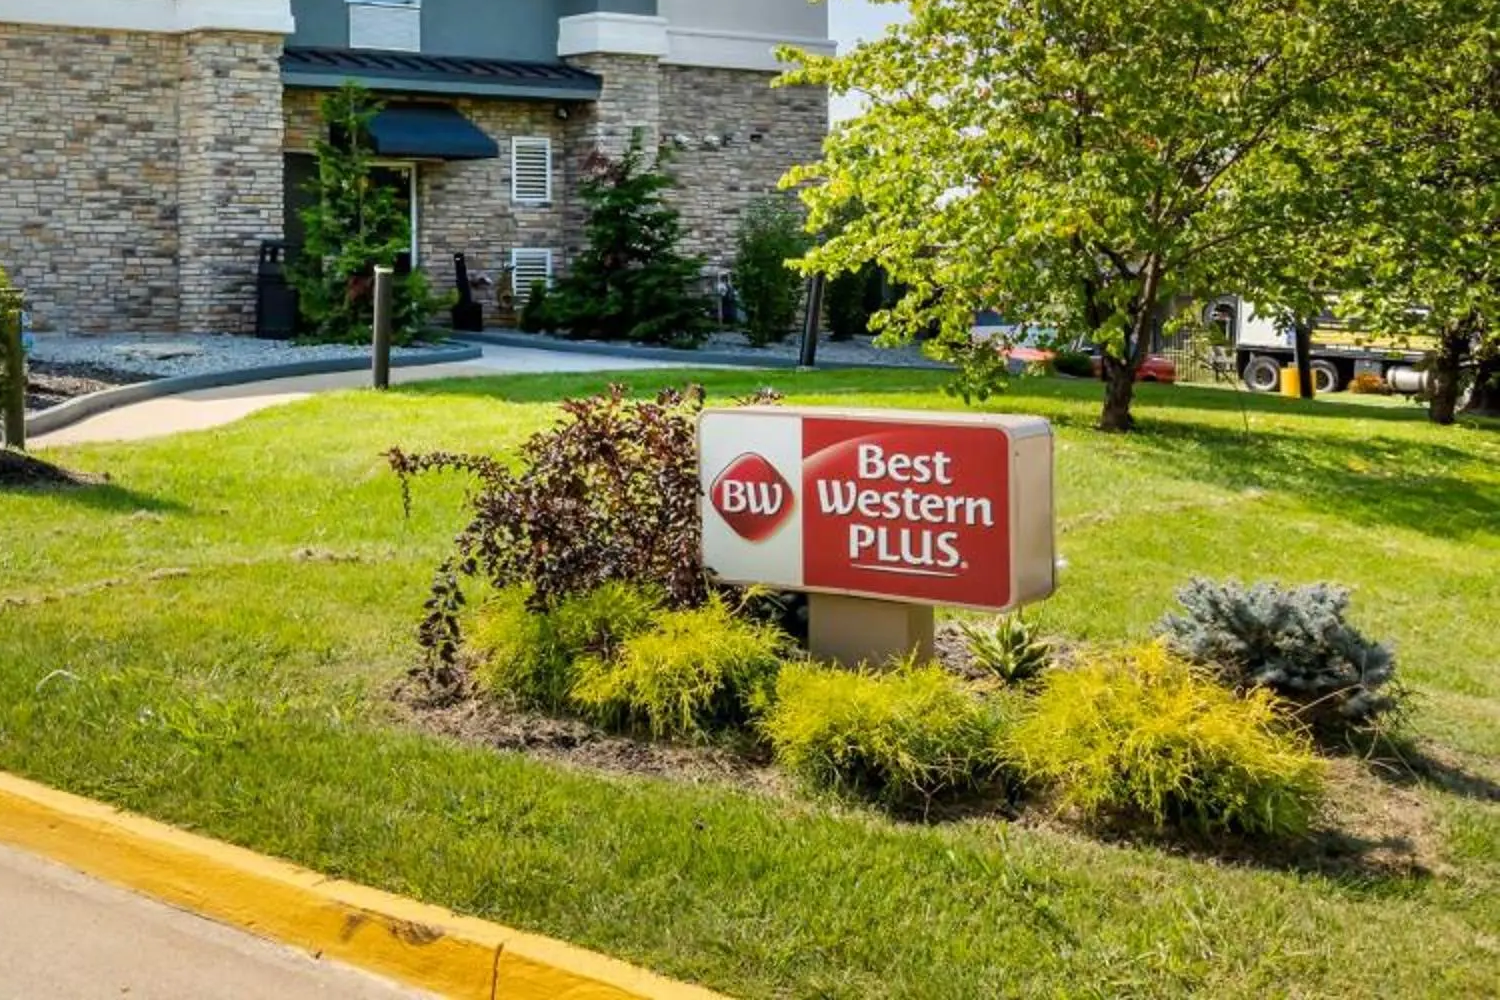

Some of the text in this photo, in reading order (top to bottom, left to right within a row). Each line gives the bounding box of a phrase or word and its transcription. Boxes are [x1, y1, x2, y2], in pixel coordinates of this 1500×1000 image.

[858, 443, 953, 485] Best
[722, 479, 783, 515] BW
[817, 479, 994, 527] Western
[849, 523, 961, 568] PLUS
